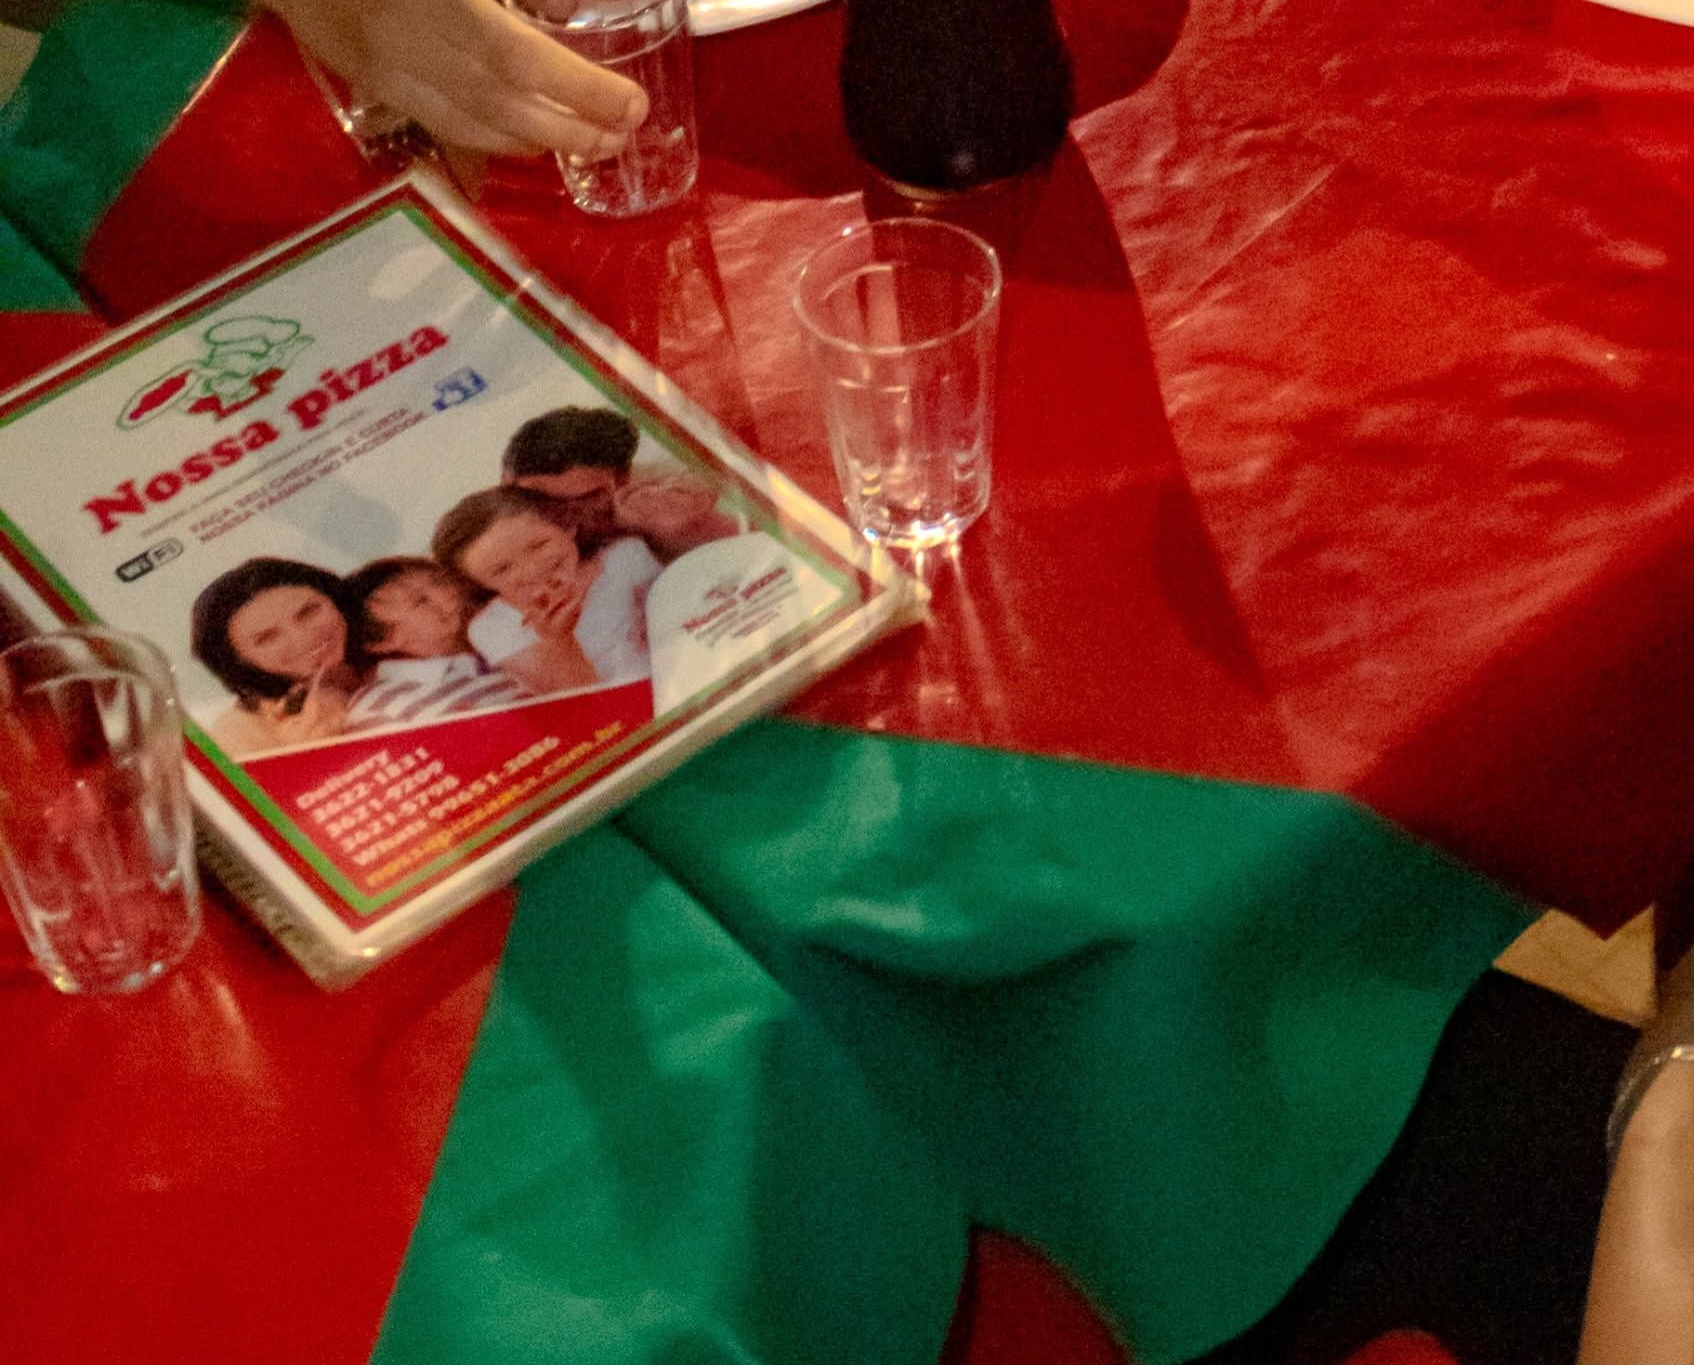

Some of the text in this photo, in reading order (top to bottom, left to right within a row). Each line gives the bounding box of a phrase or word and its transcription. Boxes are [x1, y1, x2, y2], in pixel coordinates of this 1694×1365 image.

[83, 420, 281, 535] Nossa
[287, 325, 450, 430] pizza
[296, 749, 391, 810] Delivery
